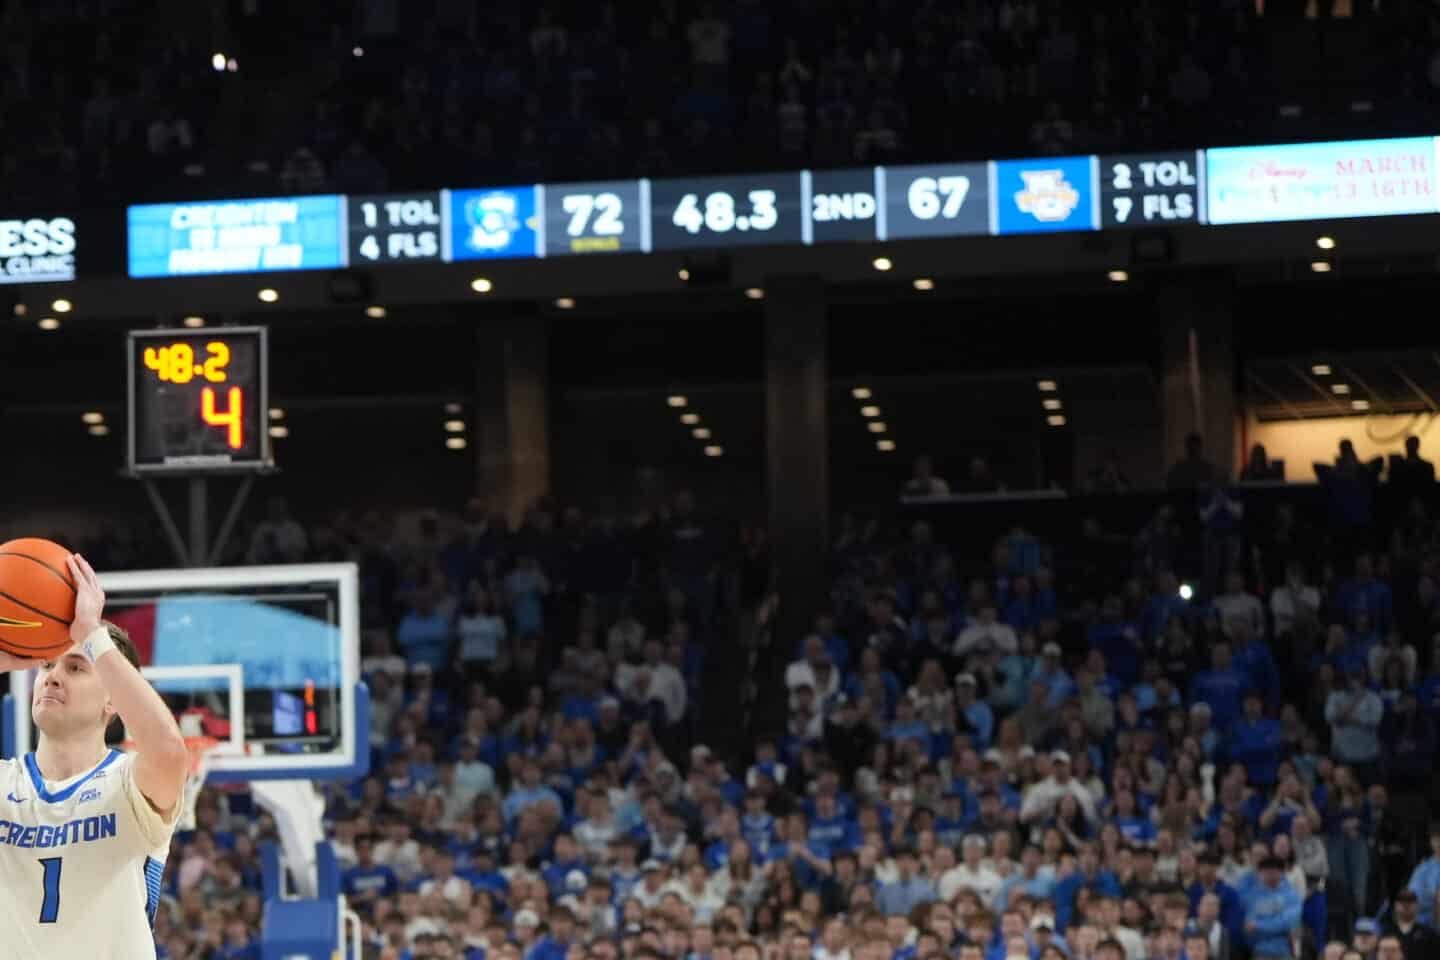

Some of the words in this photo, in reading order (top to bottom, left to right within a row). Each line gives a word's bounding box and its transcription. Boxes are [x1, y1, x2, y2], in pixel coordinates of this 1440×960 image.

[1112, 163, 1131, 188] 2
[1140, 159, 1196, 187] TOL
[361, 202, 378, 228] 1
[384, 199, 439, 226] TOL
[562, 193, 624, 237] 72
[672, 188, 777, 232] 48.3
[814, 193, 875, 222] 2ND
[907, 176, 969, 219] 67
[1114, 196, 1133, 222] 7
[1143, 193, 1194, 220] FLS
[360, 235, 380, 260] 4
[387, 232, 438, 258] FLS
[143, 341, 230, 383] 48.2
[201, 386, 243, 449] 4
[38, 857, 63, 923] 1
